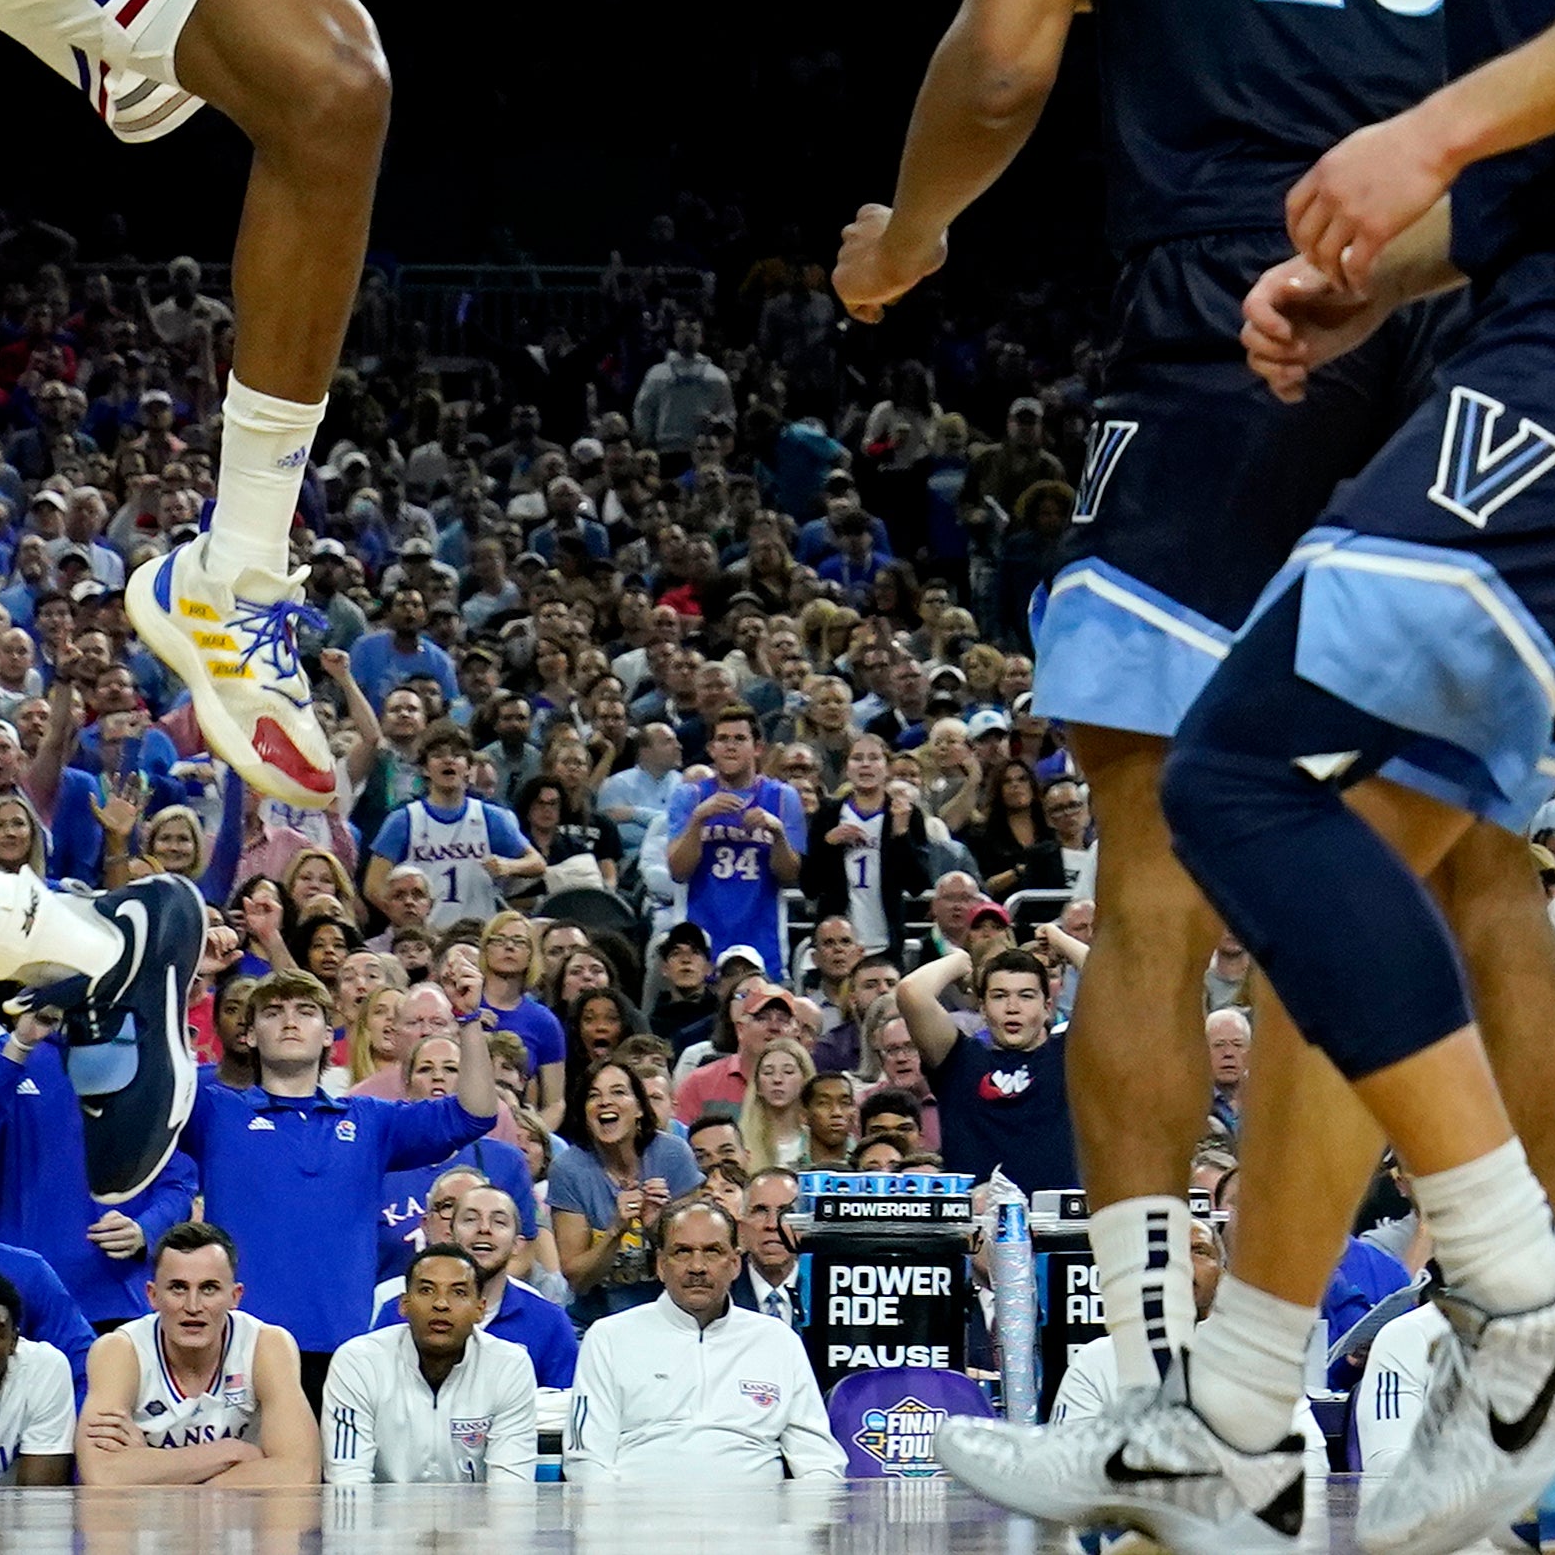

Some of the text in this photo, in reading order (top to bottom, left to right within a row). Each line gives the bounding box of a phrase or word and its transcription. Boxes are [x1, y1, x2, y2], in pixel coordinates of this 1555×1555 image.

[414, 842, 486, 863] KANSAS
[711, 846, 760, 881] 34
[442, 866, 462, 903] 1
[853, 856, 869, 889] 1
[839, 1202, 931, 1217] POWERADE
[829, 1265, 951, 1296] POWER
[828, 1296, 900, 1326] ADE
[827, 1344, 949, 1368] PAUSE
[887, 1435, 935, 1459] FOU
